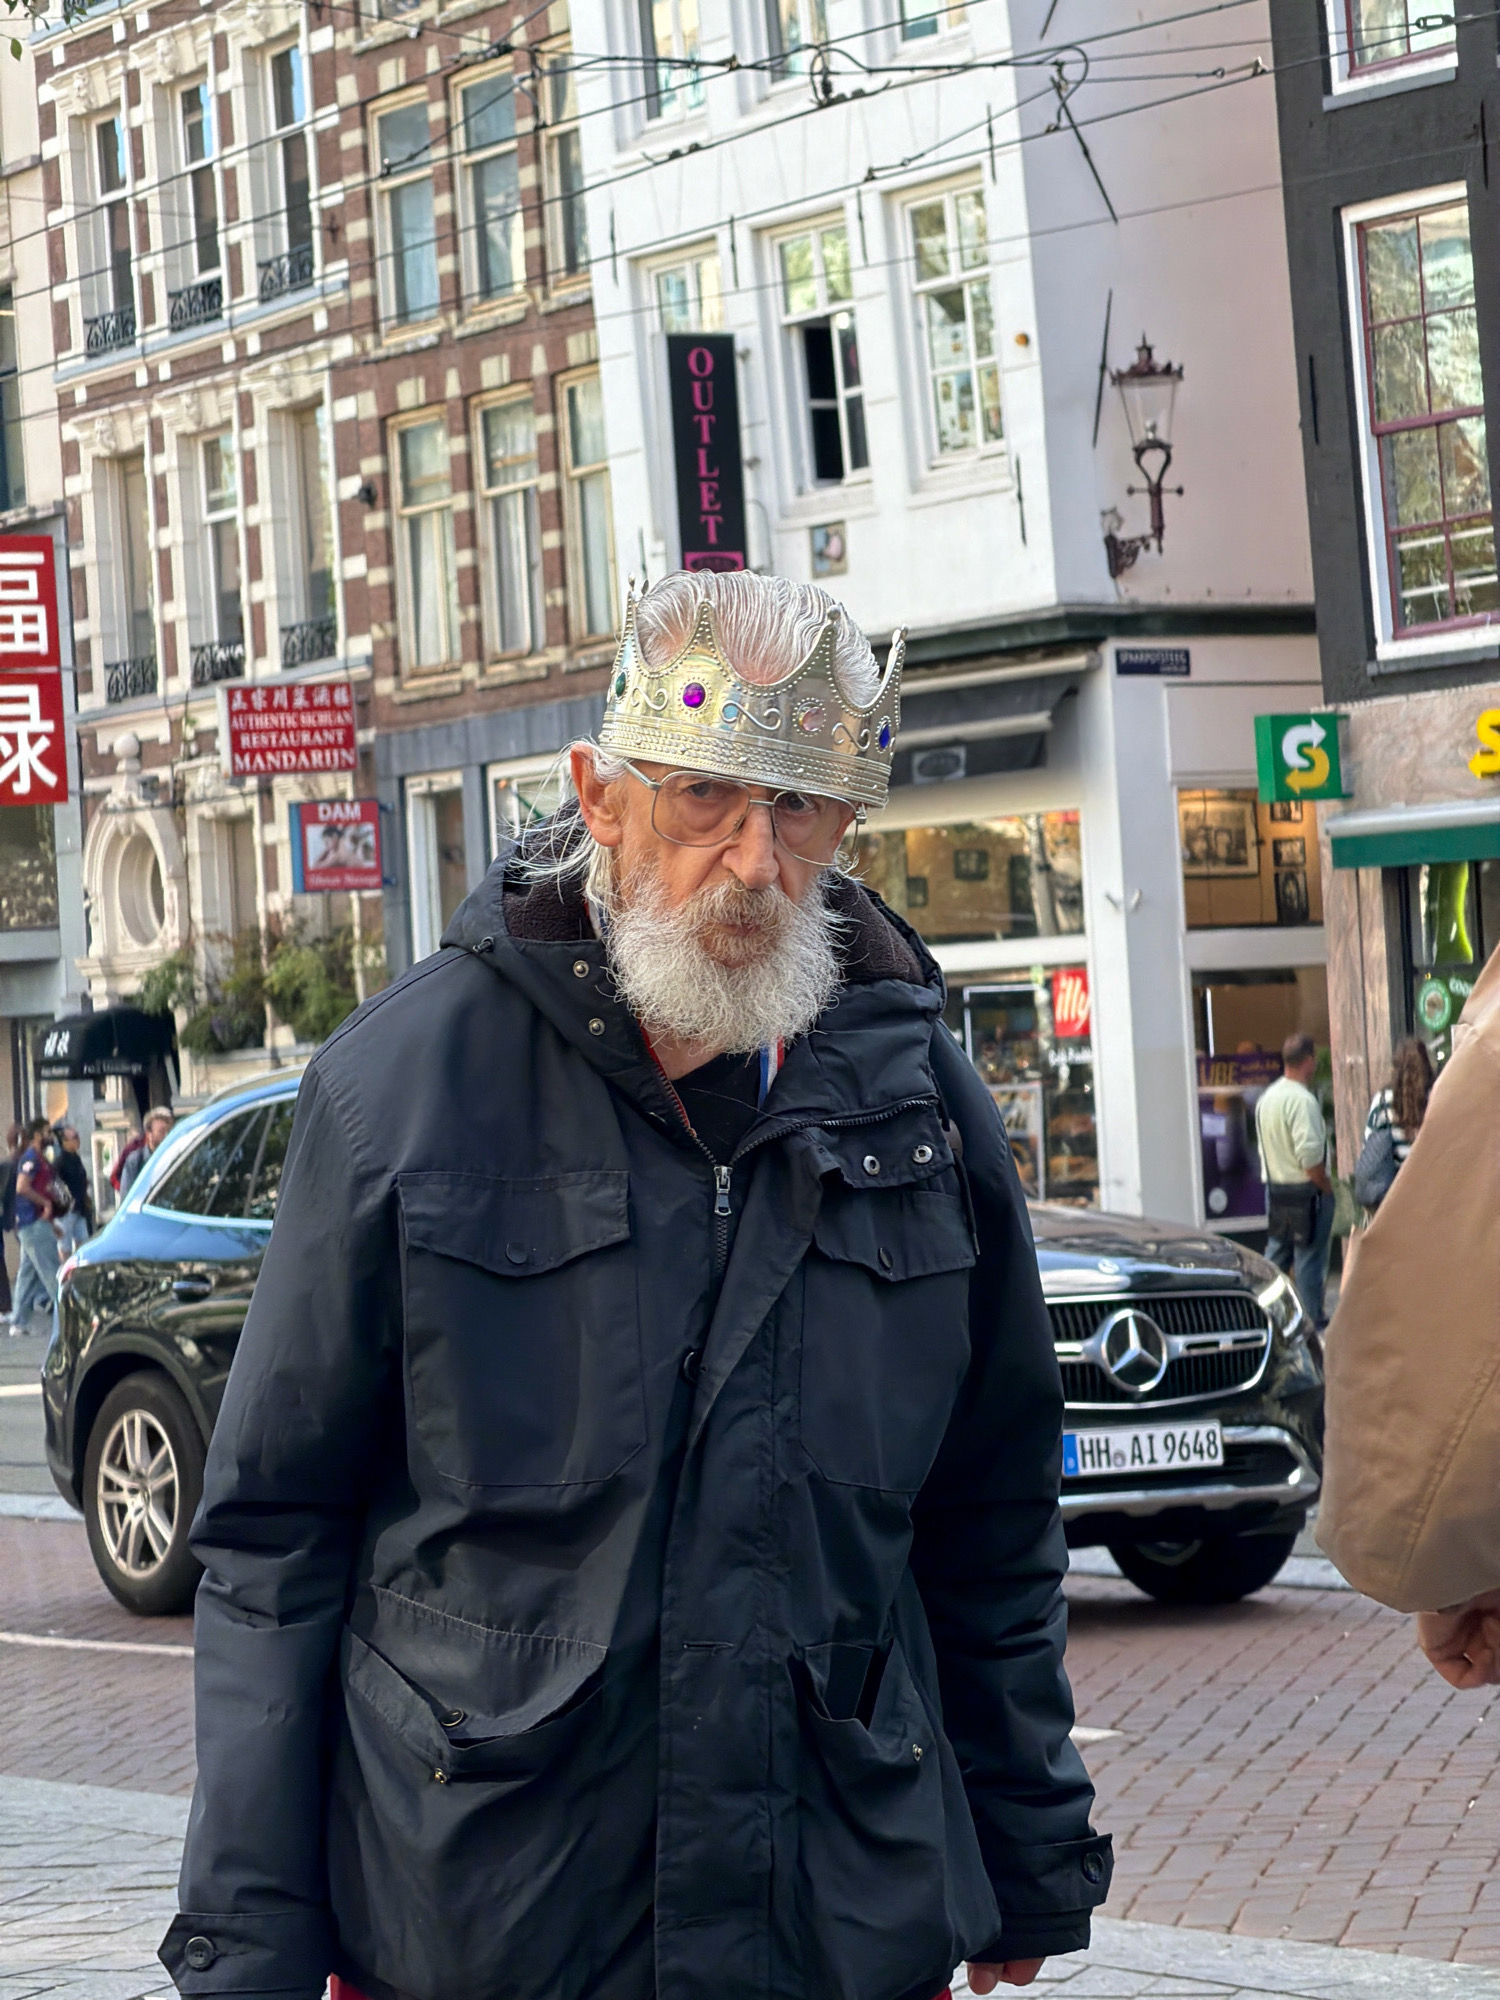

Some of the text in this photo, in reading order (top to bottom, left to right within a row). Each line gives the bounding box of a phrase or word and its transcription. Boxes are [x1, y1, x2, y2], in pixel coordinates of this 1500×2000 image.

[688, 347, 724, 545] OUTLET
[231, 712, 299, 730] AUTHENTIC
[241, 728, 346, 750] RESTAURANT
[234, 748, 356, 772] MANDARIJN
[317, 802, 362, 822] DAM
[1055, 976, 1092, 1032] illy
[1079, 1428, 1219, 1470] HH AI 9648
